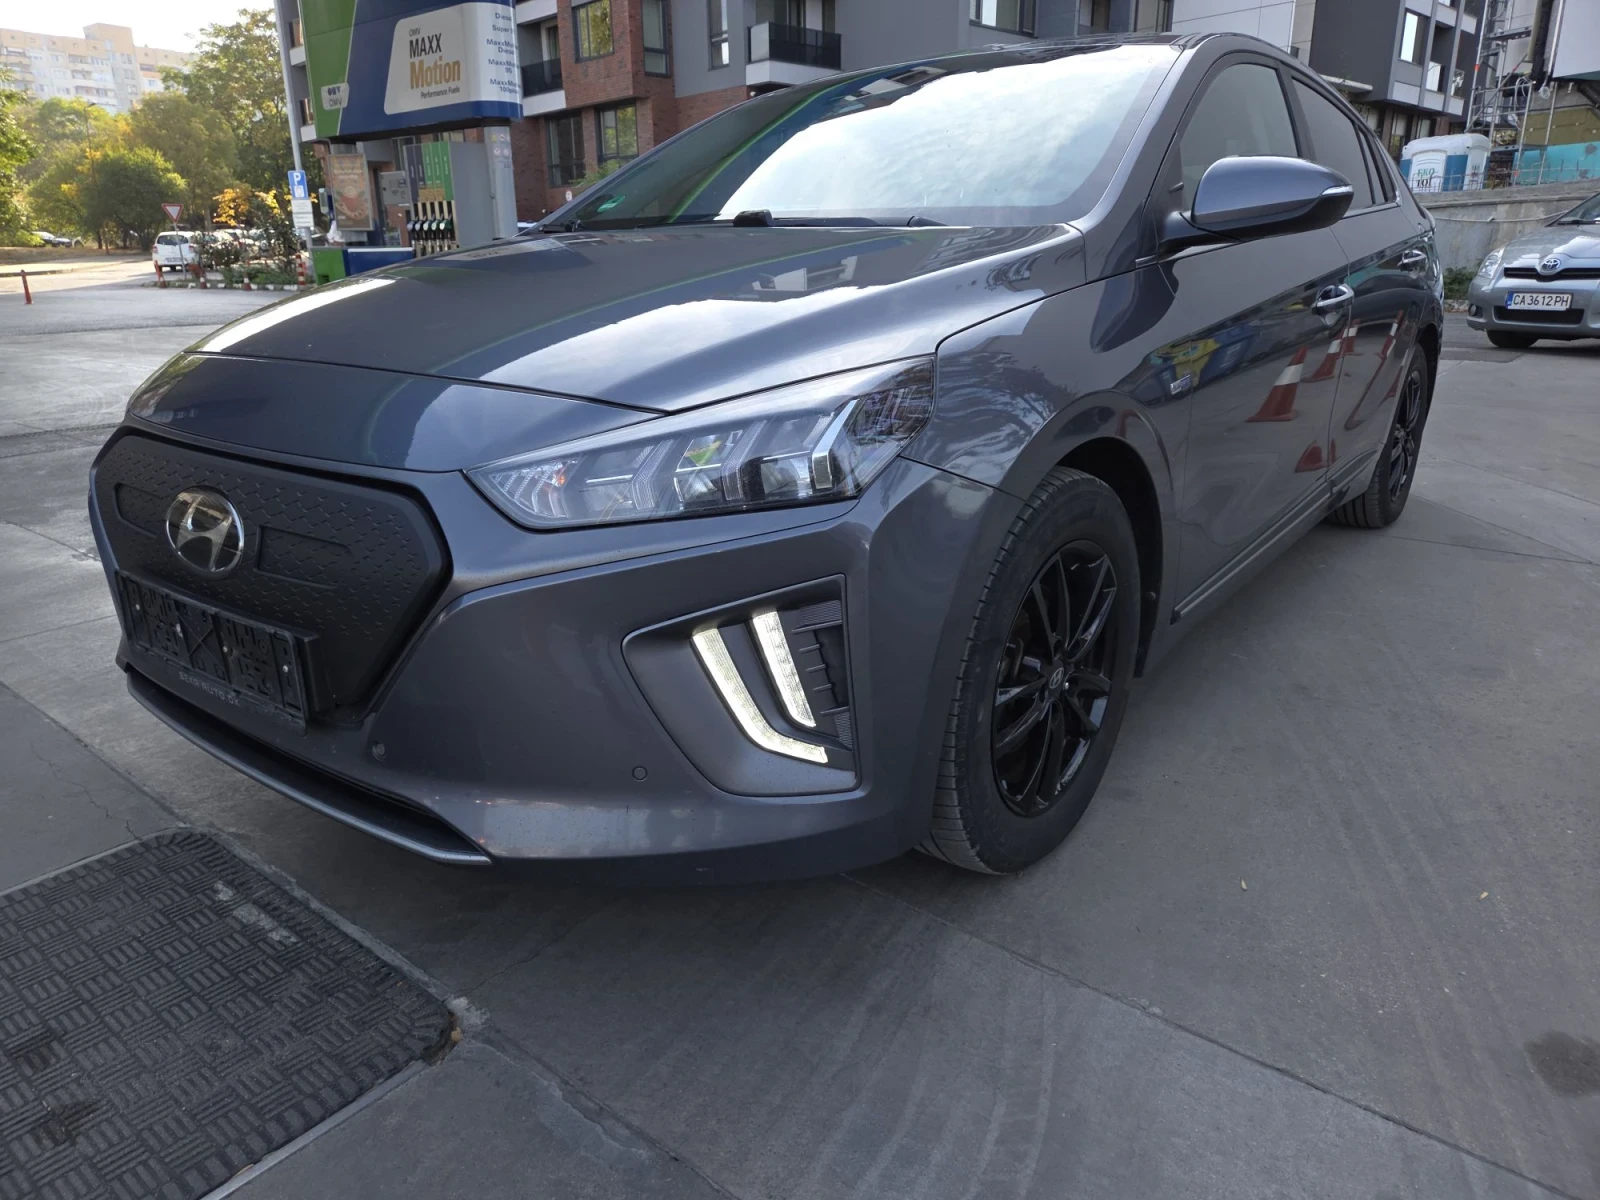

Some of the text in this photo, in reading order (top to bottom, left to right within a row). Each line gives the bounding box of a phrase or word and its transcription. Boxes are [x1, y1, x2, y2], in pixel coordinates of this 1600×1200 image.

[408, 28, 421, 37] OMV
[409, 33, 442, 59] MAXX
[409, 56, 461, 90] Motion
[420, 86, 460, 99] Performance Fuels
[328, 98, 343, 107] OMV
[293, 172, 302, 186] P
